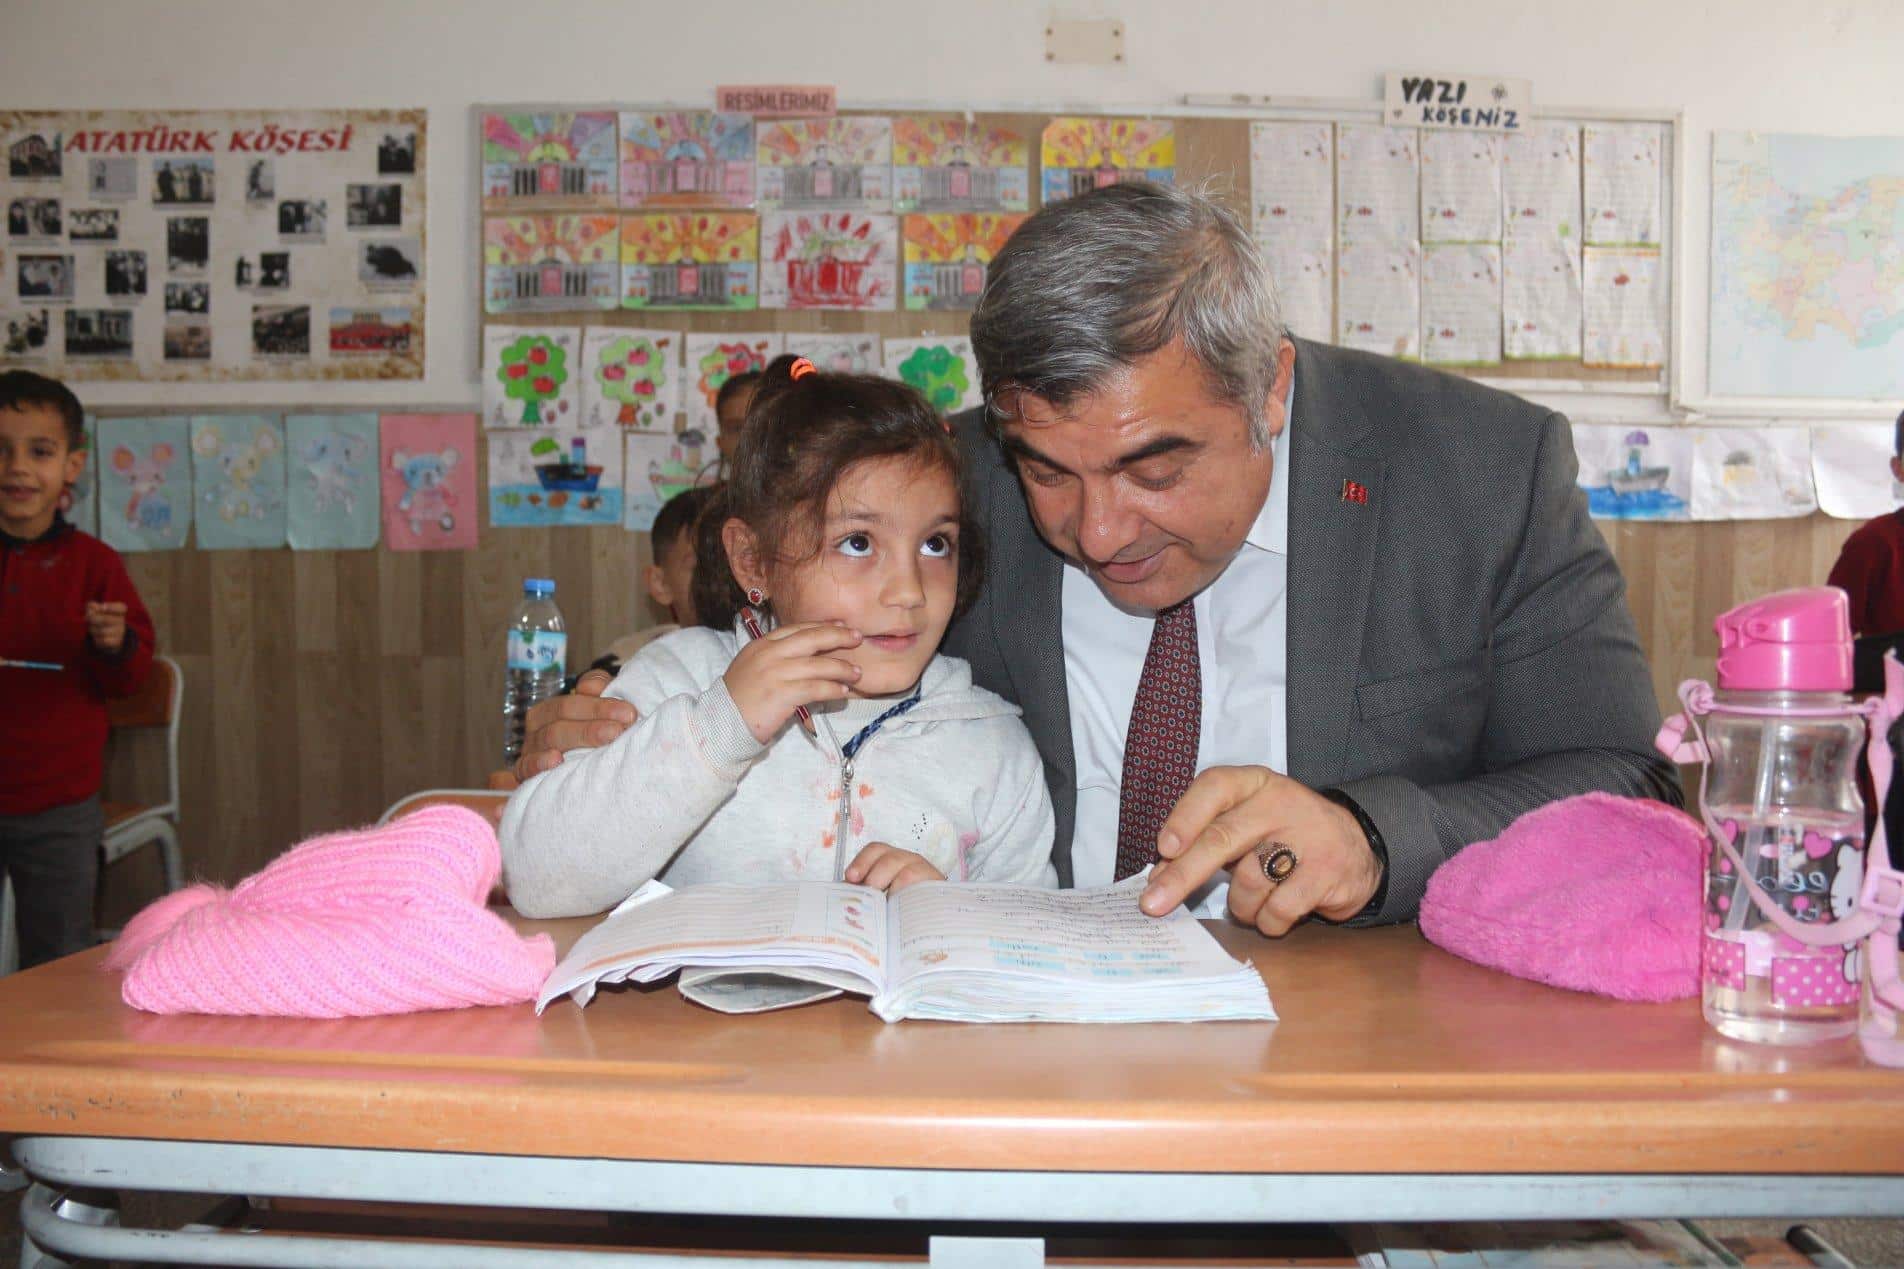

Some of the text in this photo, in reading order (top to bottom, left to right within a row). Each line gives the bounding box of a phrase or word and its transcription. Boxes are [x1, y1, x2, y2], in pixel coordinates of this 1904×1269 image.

[1401, 77, 1467, 104] YAZI
[65, 123, 353, 154] ATATÜRK KÖŞESİ
